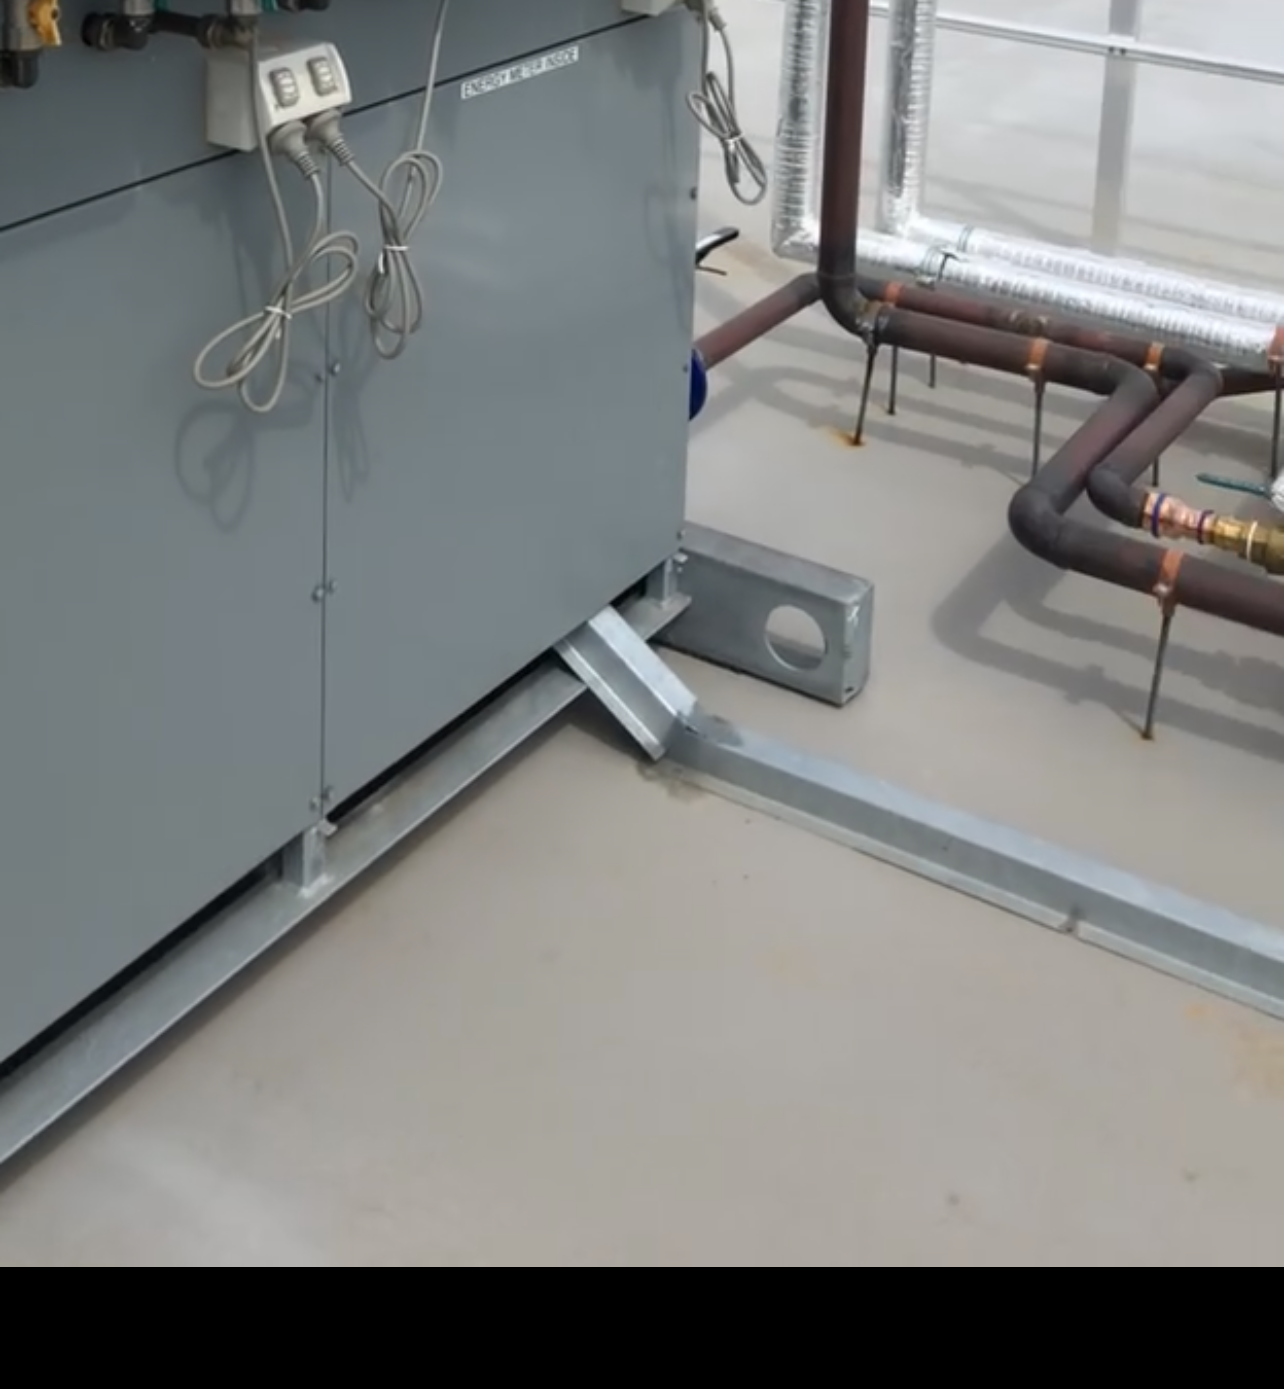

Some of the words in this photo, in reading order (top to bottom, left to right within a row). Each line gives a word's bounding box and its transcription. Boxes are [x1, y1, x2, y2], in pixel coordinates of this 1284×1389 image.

[464, 72, 507, 98] ENERGY
[508, 60, 543, 83] METER
[546, 48, 577, 69] INSIDE
